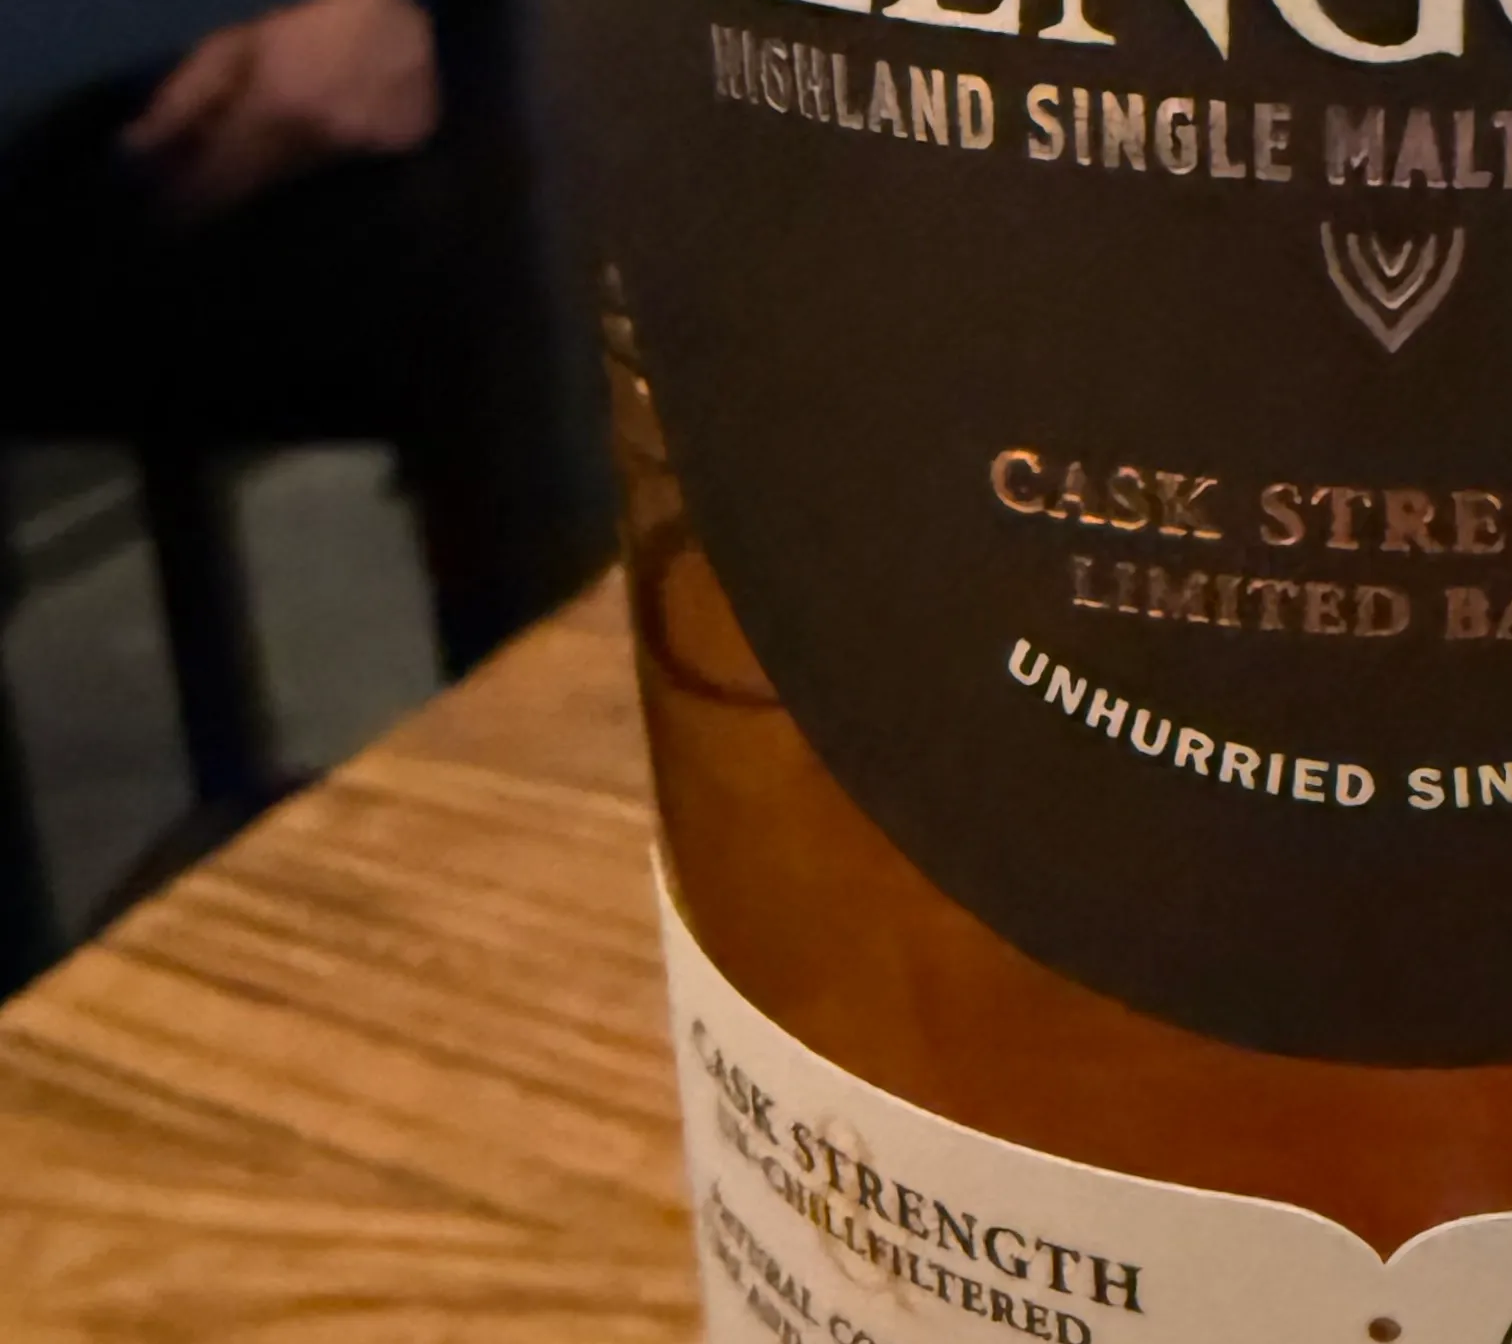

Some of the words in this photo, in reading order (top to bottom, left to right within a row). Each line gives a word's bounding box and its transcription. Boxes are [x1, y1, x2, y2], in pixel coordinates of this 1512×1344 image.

[711, 23, 994, 150] HIGHLAND
[1027, 83, 1293, 181] SINGLE
[990, 448, 1222, 540] CASK
[1071, 555, 1411, 638] LIMITED
[1007, 638, 1376, 809] UNHURRIED
[689, 1017, 780, 1146] CASK
[791, 1120, 1144, 1315] STRENGTH
